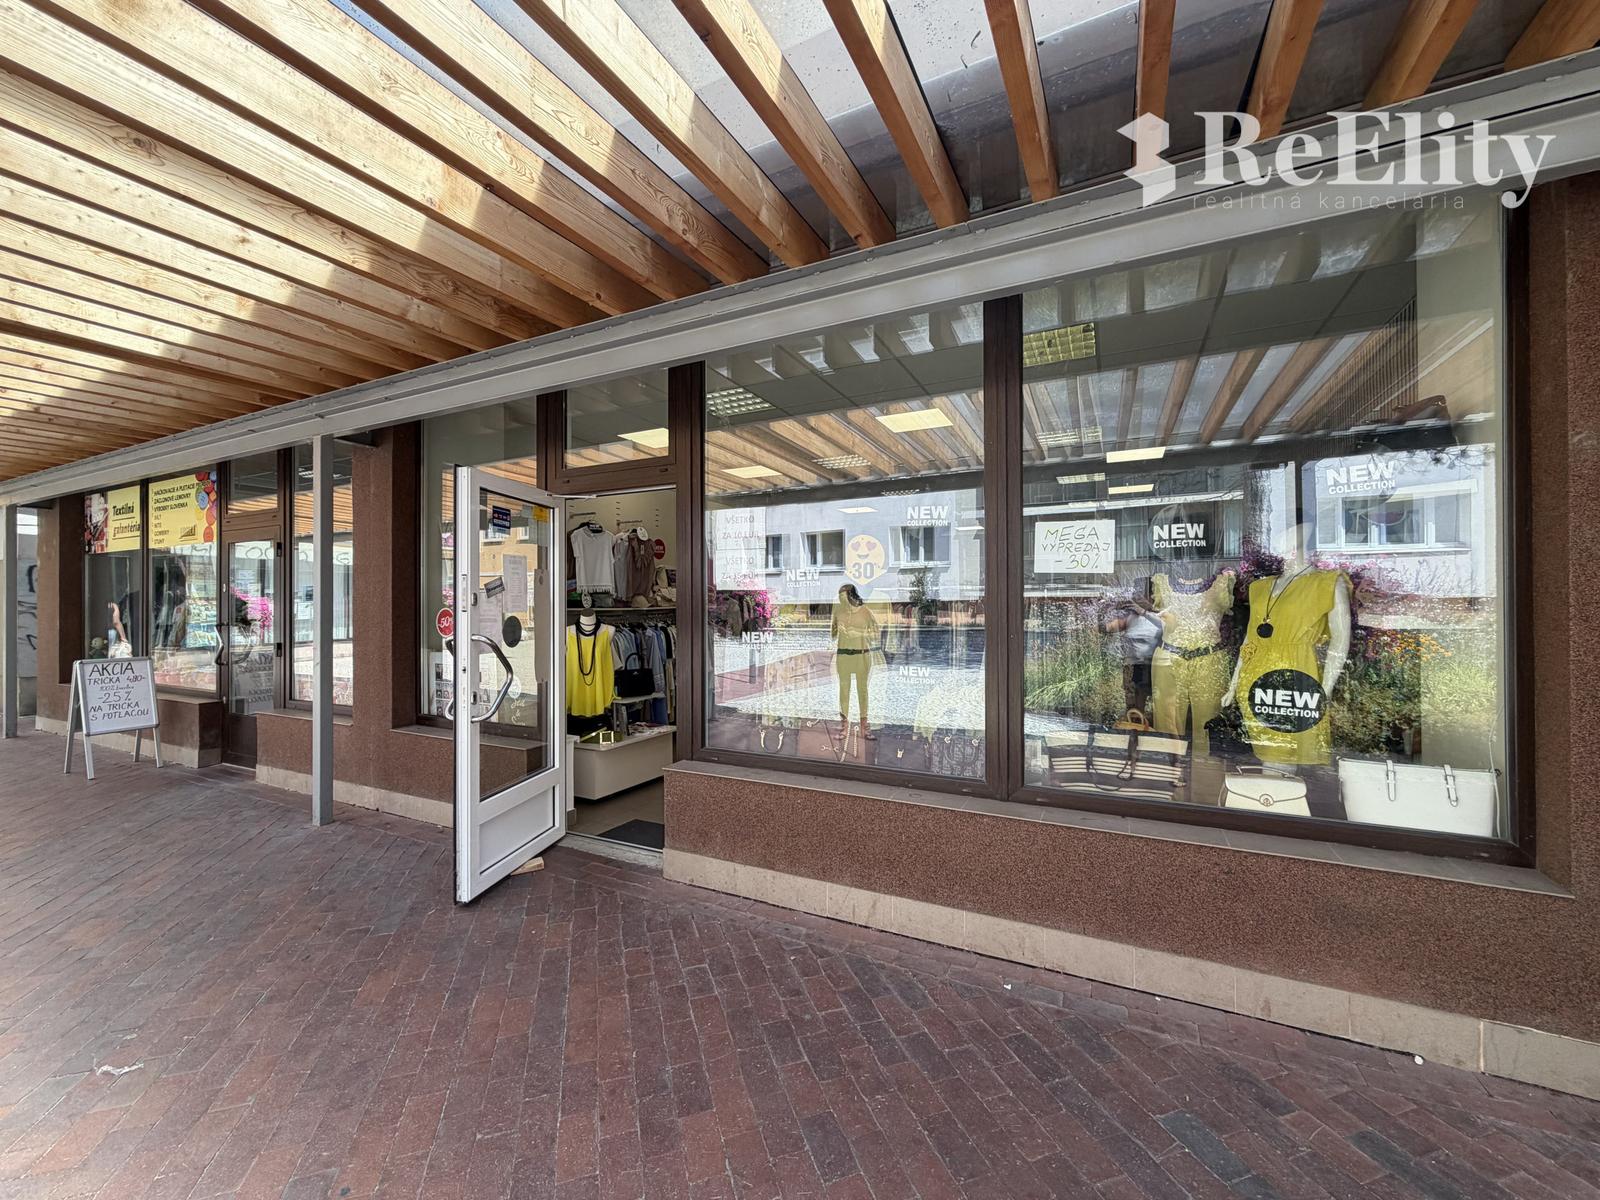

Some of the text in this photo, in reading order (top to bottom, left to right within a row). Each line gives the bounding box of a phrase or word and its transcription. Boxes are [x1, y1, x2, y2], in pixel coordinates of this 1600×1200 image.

[1326, 461, 1395, 485] NEW
[1328, 480, 1396, 495] COLLECTION
[112, 501, 135, 517] Textilná
[907, 506, 948, 519] NEW
[1044, 525, 1100, 542] MEGA
[1153, 523, 1205, 541] NEW
[1154, 539, 1207, 549] COLLECTION
[1054, 553, 1104, 570] -30%
[786, 568, 820, 582] NEW
[742, 631, 774, 644] NEW
[88, 662, 135, 678] AKCIA
[900, 666, 931, 677] NEW
[1254, 688, 1321, 709] NEW
[88, 705, 103, 713] NA
[1254, 705, 1319, 719] COLLECTION
[90, 713, 98, 721] S
